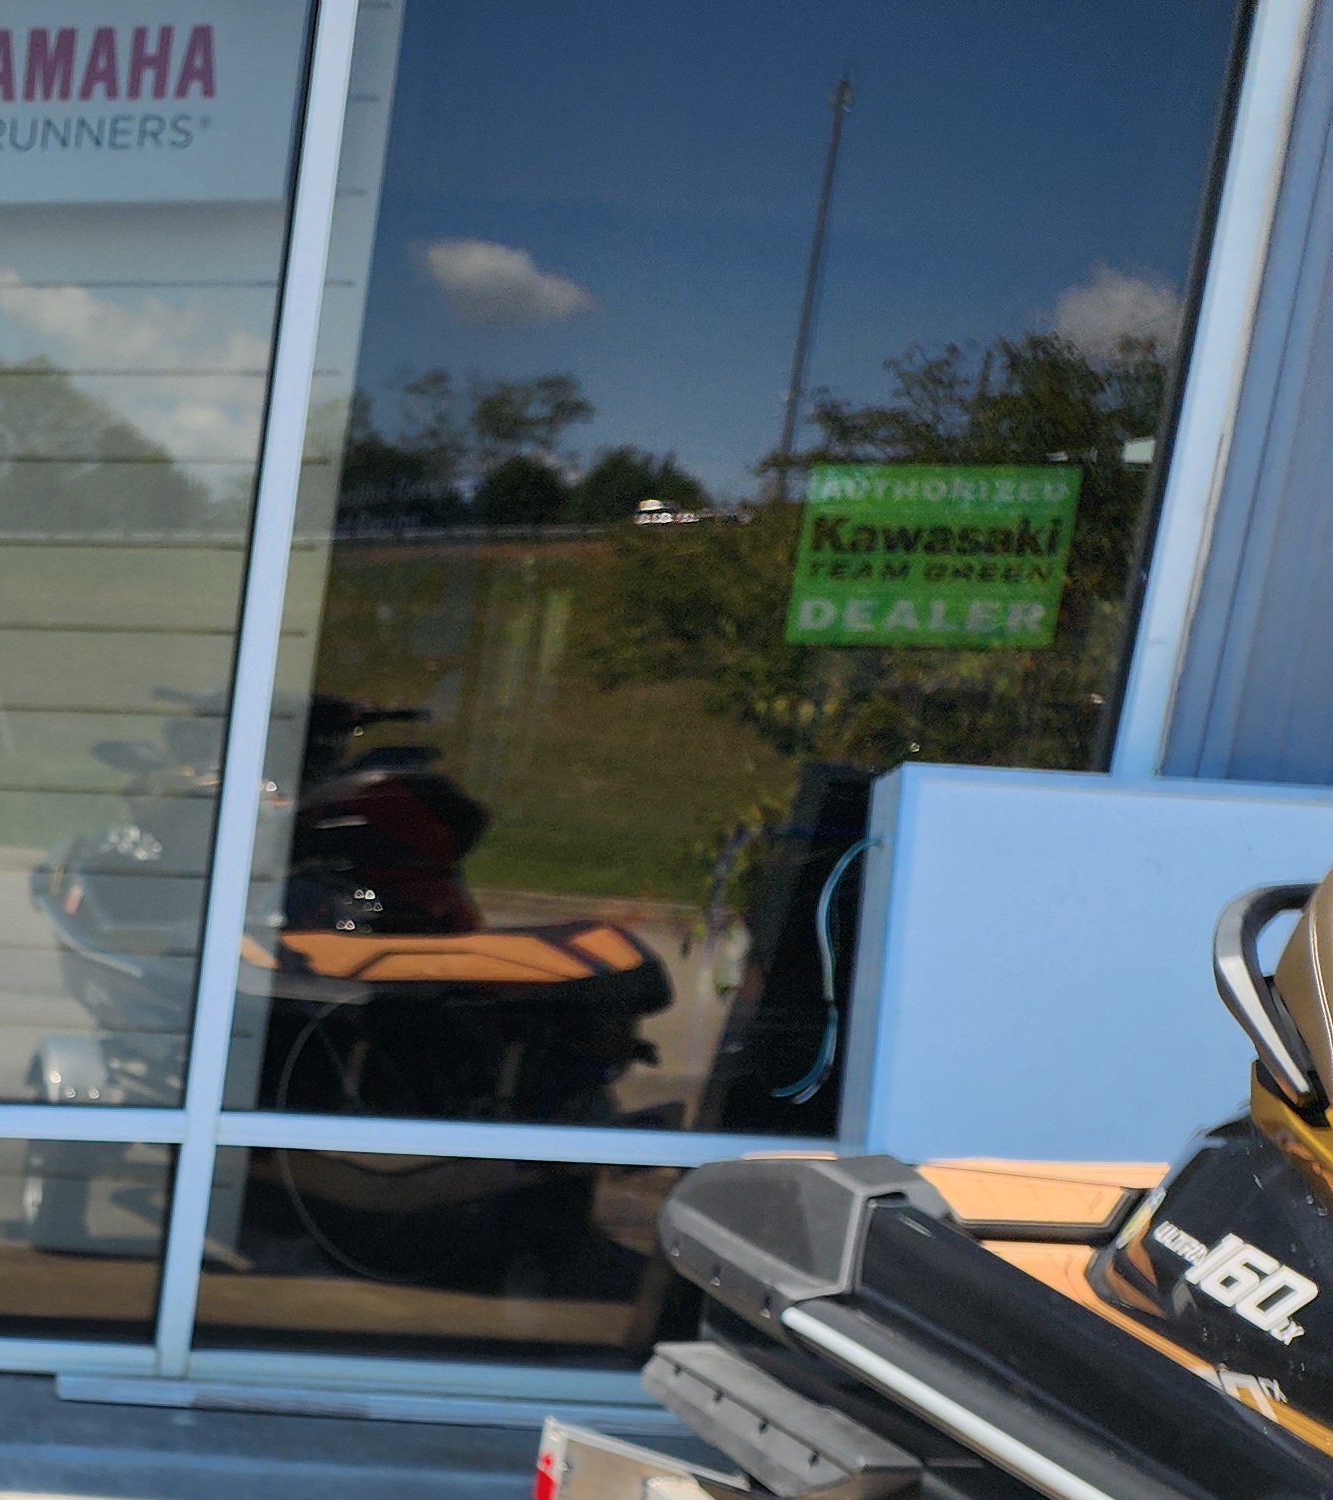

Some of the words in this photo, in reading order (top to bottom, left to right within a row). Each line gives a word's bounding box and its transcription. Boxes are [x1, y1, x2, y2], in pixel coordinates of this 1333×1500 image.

[807, 513, 1065, 556] Kawasaki
[808, 560, 912, 581] TEAM
[923, 562, 1055, 583] GREEN
[796, 600, 1048, 633] DEALER
[1152, 1220, 1210, 1268] ULTRA
[1184, 1232, 1319, 1331] 160
